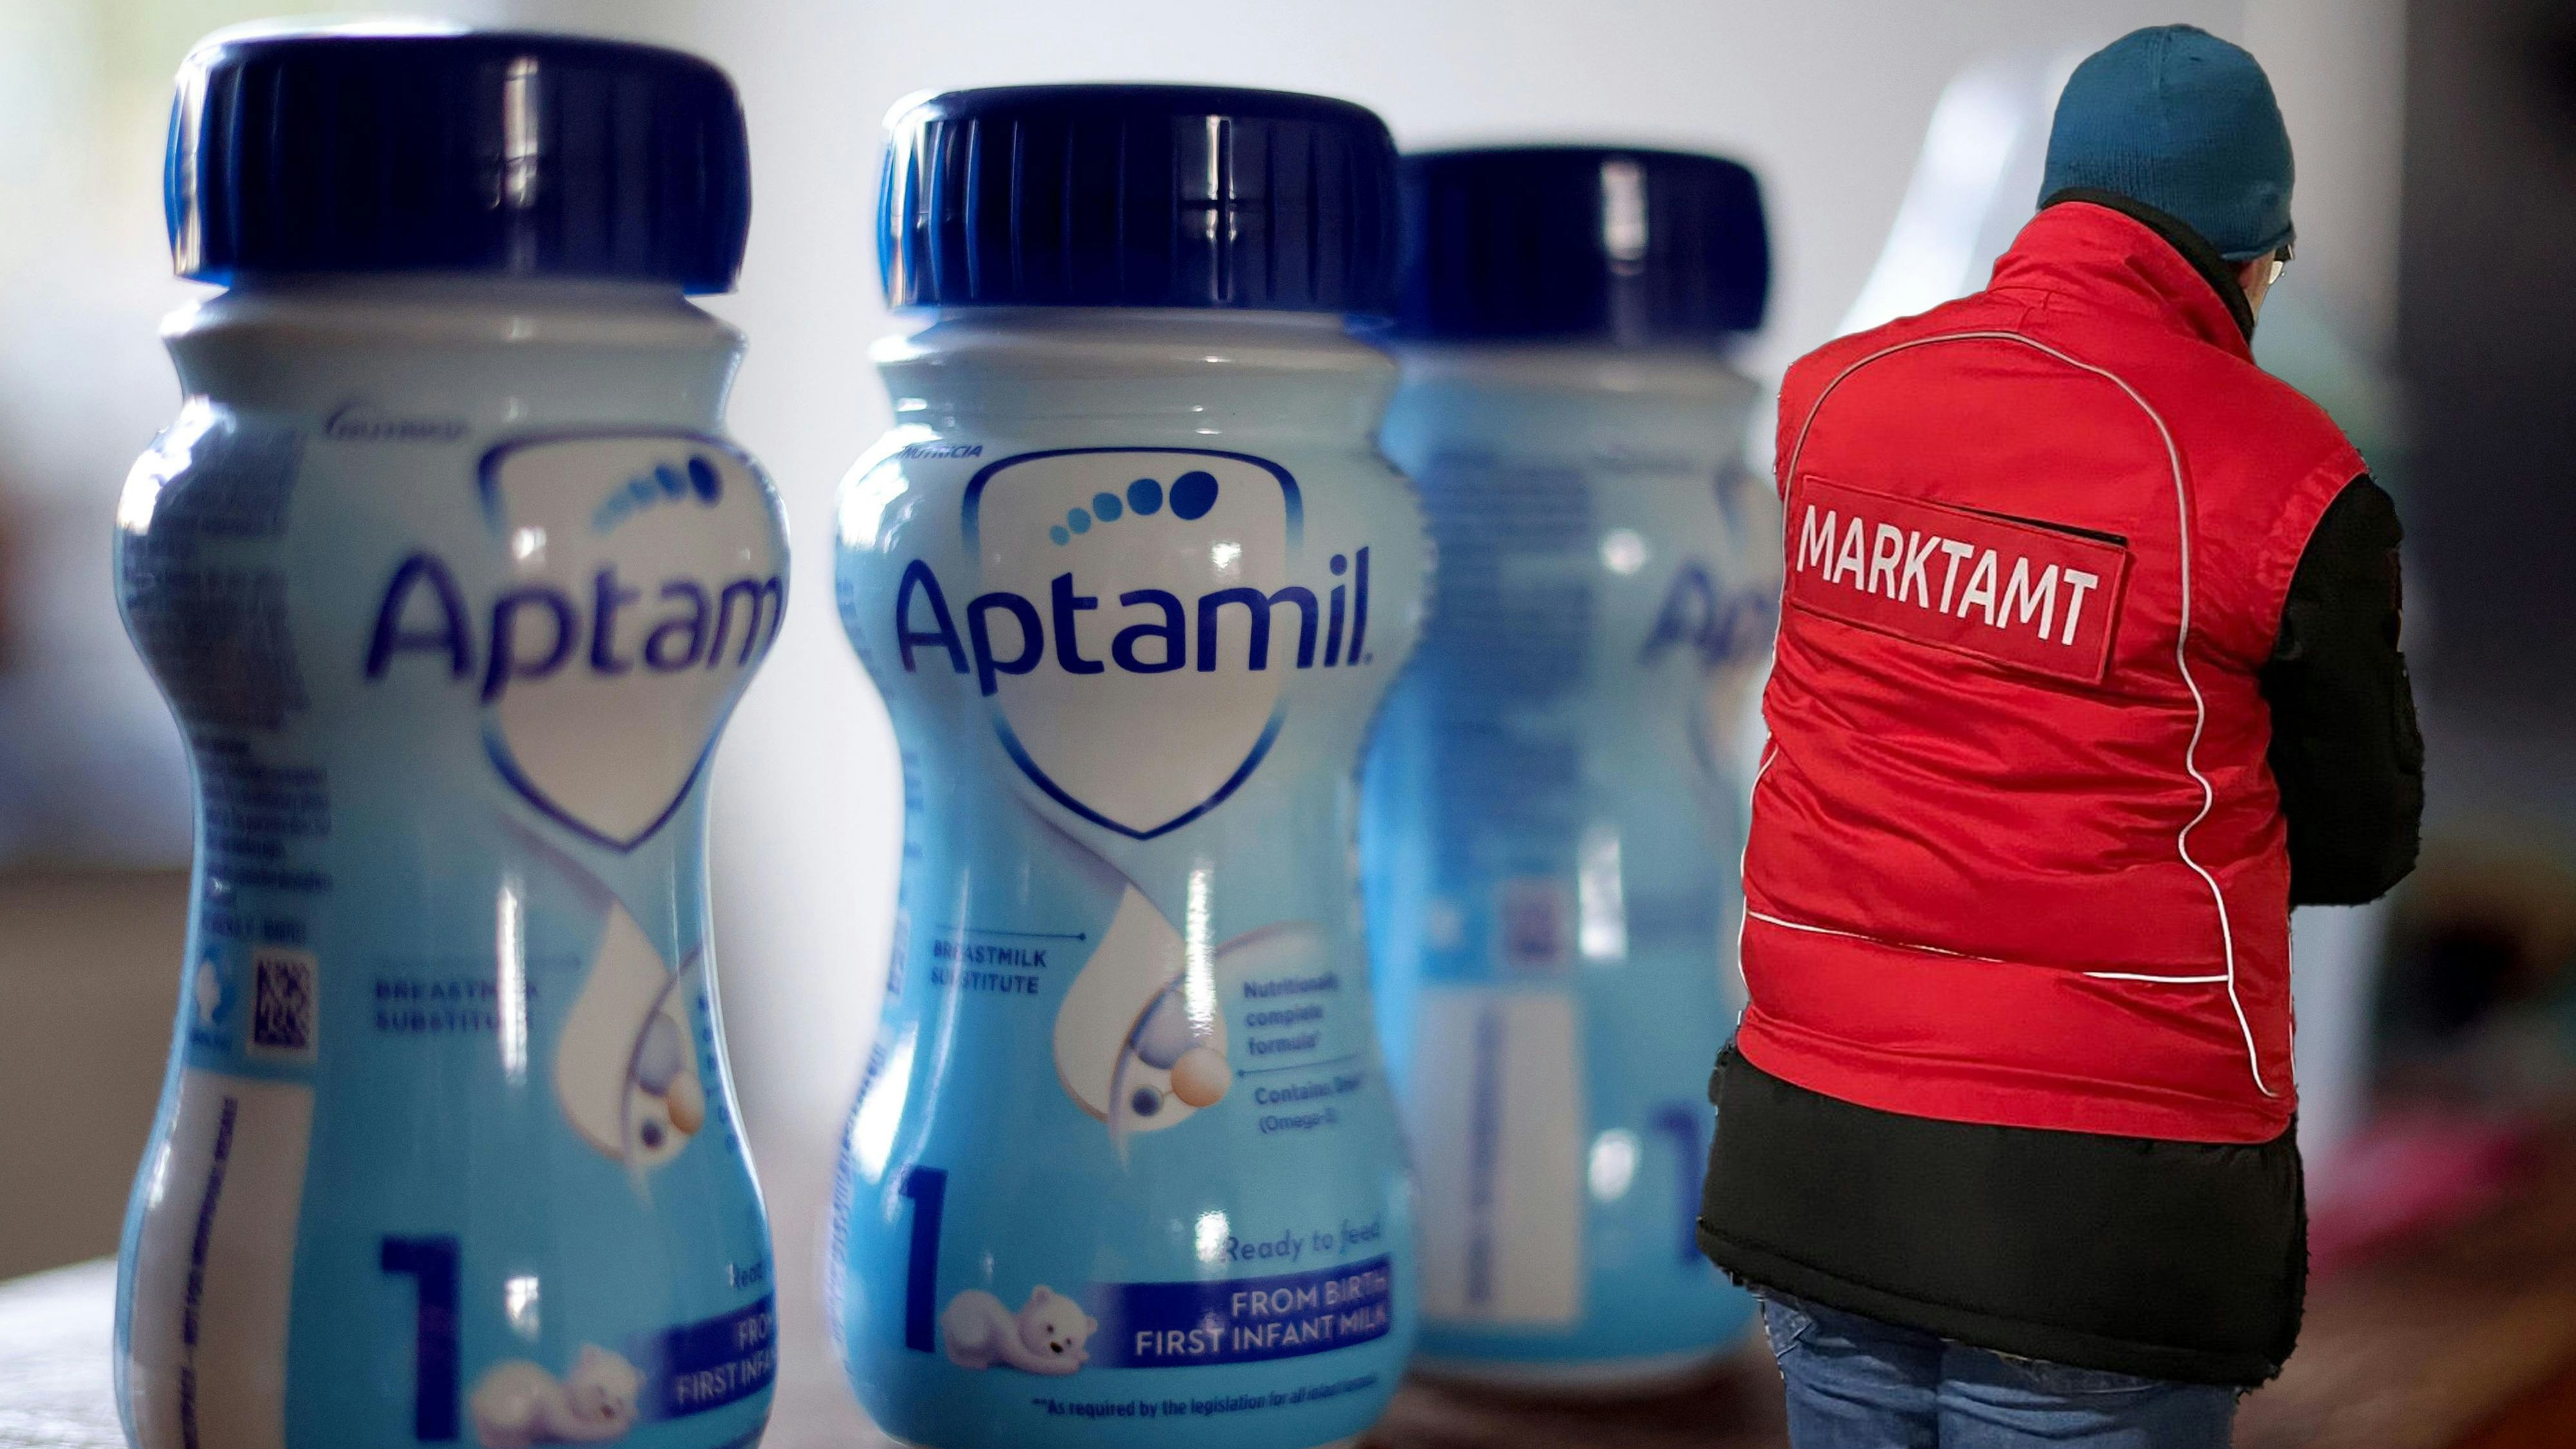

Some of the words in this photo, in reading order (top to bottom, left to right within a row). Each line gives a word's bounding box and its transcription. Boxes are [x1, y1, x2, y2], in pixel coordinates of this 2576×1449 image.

[1796, 504, 2099, 646] MARKTAMT
[896, 546, 1369, 697] Aptamil
[376, 980, 540, 1000] BREASTMK
[899, 1165, 949, 1353] 1
[1224, 1227, 1303, 1262] Ready
[1312, 1229, 1334, 1252] to
[1231, 1285, 1319, 1318] FROM
[381, 1233, 461, 1441] 1
[1135, 1327, 1226, 1356] FIRST
[1233, 1313, 1334, 1351] INFANT
[677, 1361, 737, 1405] FIRST
[1069, 1400, 1135, 1419] required
[1140, 1400, 1158, 1418] by
[1162, 1399, 1187, 1416] the
